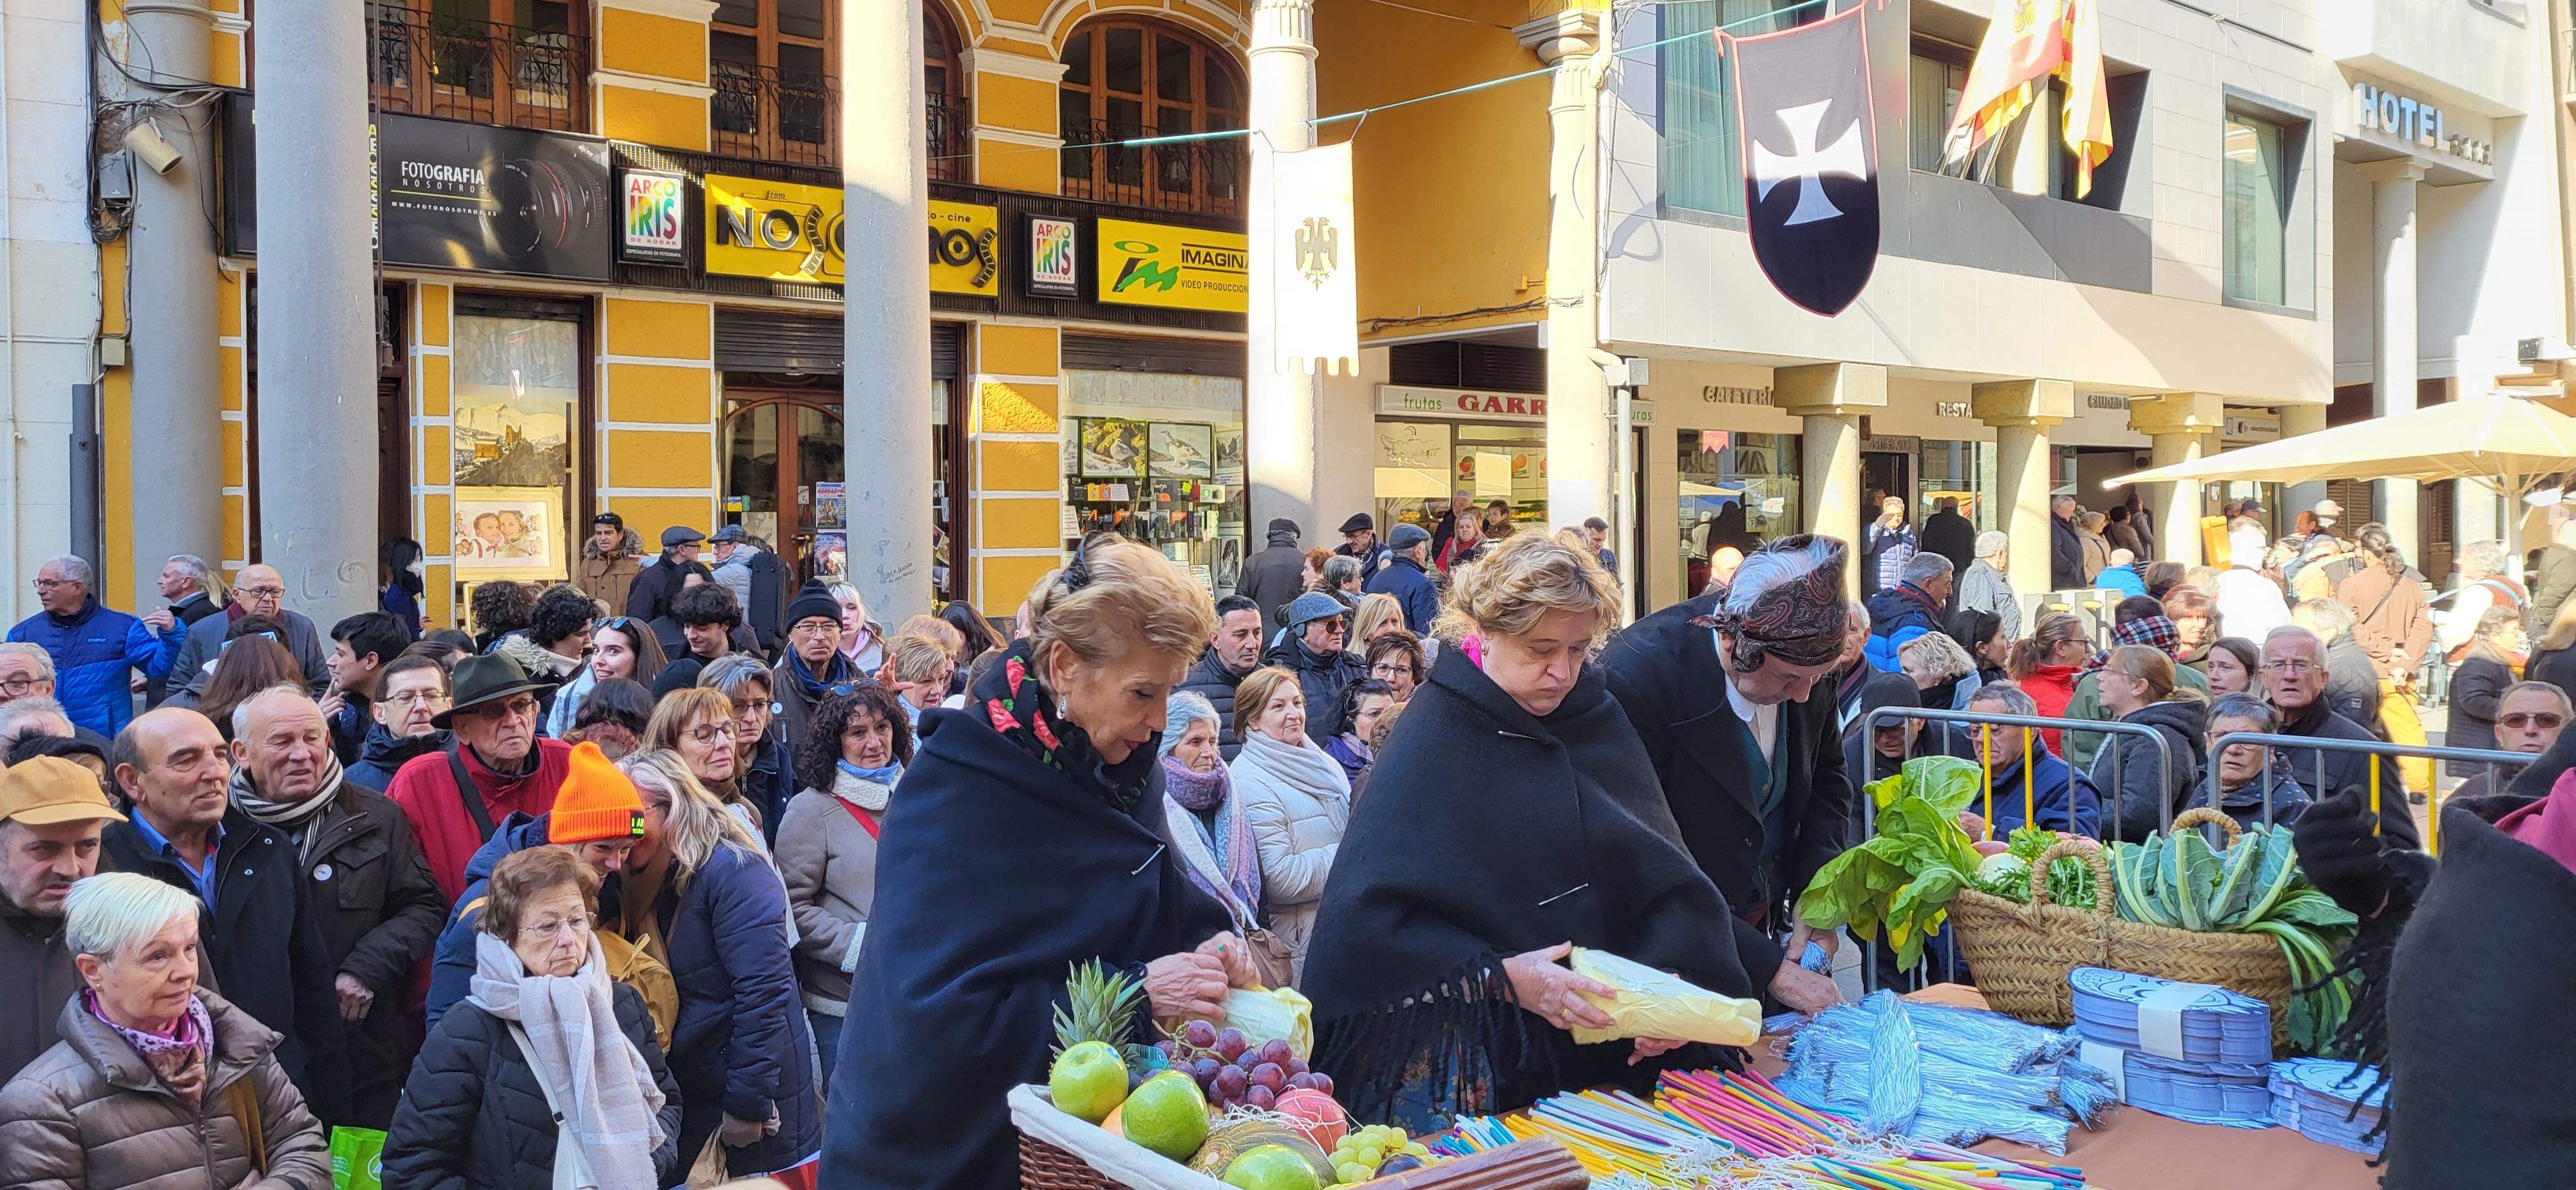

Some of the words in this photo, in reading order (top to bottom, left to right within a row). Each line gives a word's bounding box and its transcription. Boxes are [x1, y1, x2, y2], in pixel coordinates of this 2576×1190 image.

[2354, 82, 2450, 152] HOTEL
[402, 161, 484, 185] FOTOGRAFIA
[402, 178, 485, 194] NOSOTROS
[630, 178, 676, 197] ARCO
[770, 190, 786, 198] FOTO
[392, 201, 497, 216] WWW.FOTONOSOTROS.ES
[630, 194, 677, 240] IRIS
[947, 212, 971, 223] cine
[1037, 223, 1071, 239] ARCO
[1036, 237, 1071, 276] IRIS
[1181, 279, 1202, 289] VIDEO
[1404, 393, 1442, 410] frutas
[2088, 395, 2123, 409] CIUDAD
[1937, 402, 1973, 418] RESTA
